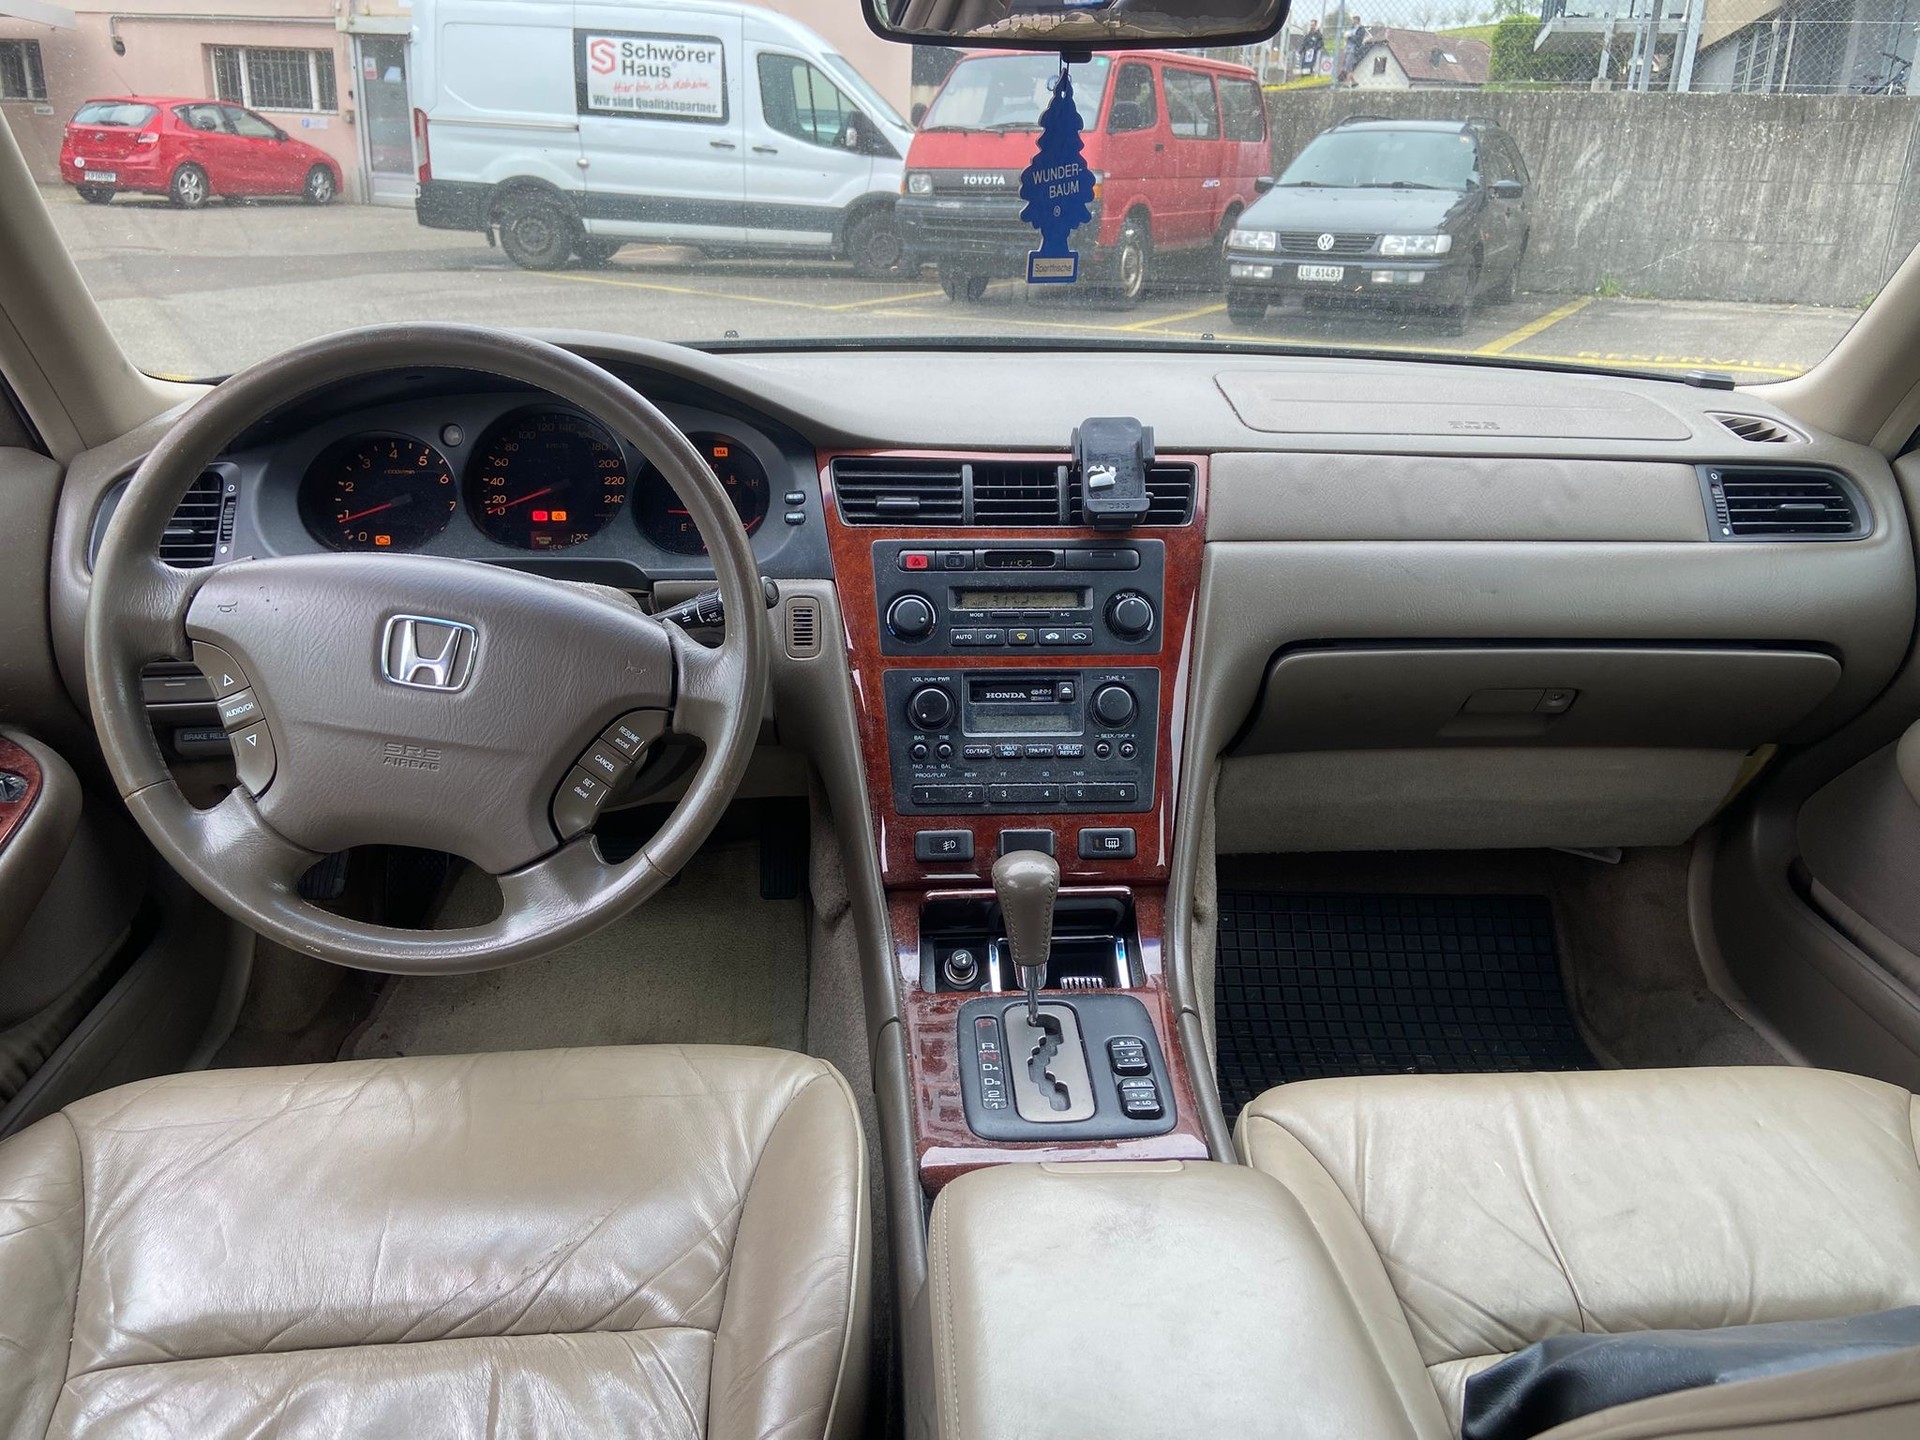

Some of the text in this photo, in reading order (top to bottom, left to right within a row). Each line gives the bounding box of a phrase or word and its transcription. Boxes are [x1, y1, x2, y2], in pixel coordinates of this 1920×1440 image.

[621, 41, 716, 64] Schwörer
[622, 60, 671, 78] Haus
[592, 95, 610, 106] Wir
[612, 96, 634, 108] sind
[1032, 163, 1082, 185] WUNDER-
[962, 176, 1006, 185] TOYOTA
[1049, 180, 1080, 199] BAUM
[389, 449, 398, 459] 4
[362, 458, 371, 469] 3
[418, 456, 428, 466] 5
[494, 458, 509, 467] 60
[598, 459, 619, 468] 200
[440, 474, 449, 484] 6
[490, 477, 505, 486] 40
[604, 476, 625, 485] 220
[345, 482, 354, 492] 2
[492, 495, 507, 504] 20
[604, 495, 625, 504] 240
[449, 501, 457, 511] 7
[680, 523, 687, 532] E
[358, 531, 368, 542] 0
[225, 702, 255, 718] AUDIO/CH
[618, 725, 641, 744] RESUME
[384, 741, 441, 760] SRS
[383, 757, 441, 772] AIRBAG
[594, 754, 615, 772] CANCEL
[582, 777, 596, 789] SET
[1001, 790, 1007, 798] 3
[1077, 789, 1083, 797] 5
[1119, 789, 1126, 797] 6
[982, 1053, 997, 1061] N
[982, 1063, 999, 1071] D4
[984, 1077, 1001, 1086] D3
[987, 1090, 1001, 1098] 2
[991, 1102, 999, 1110] 1
